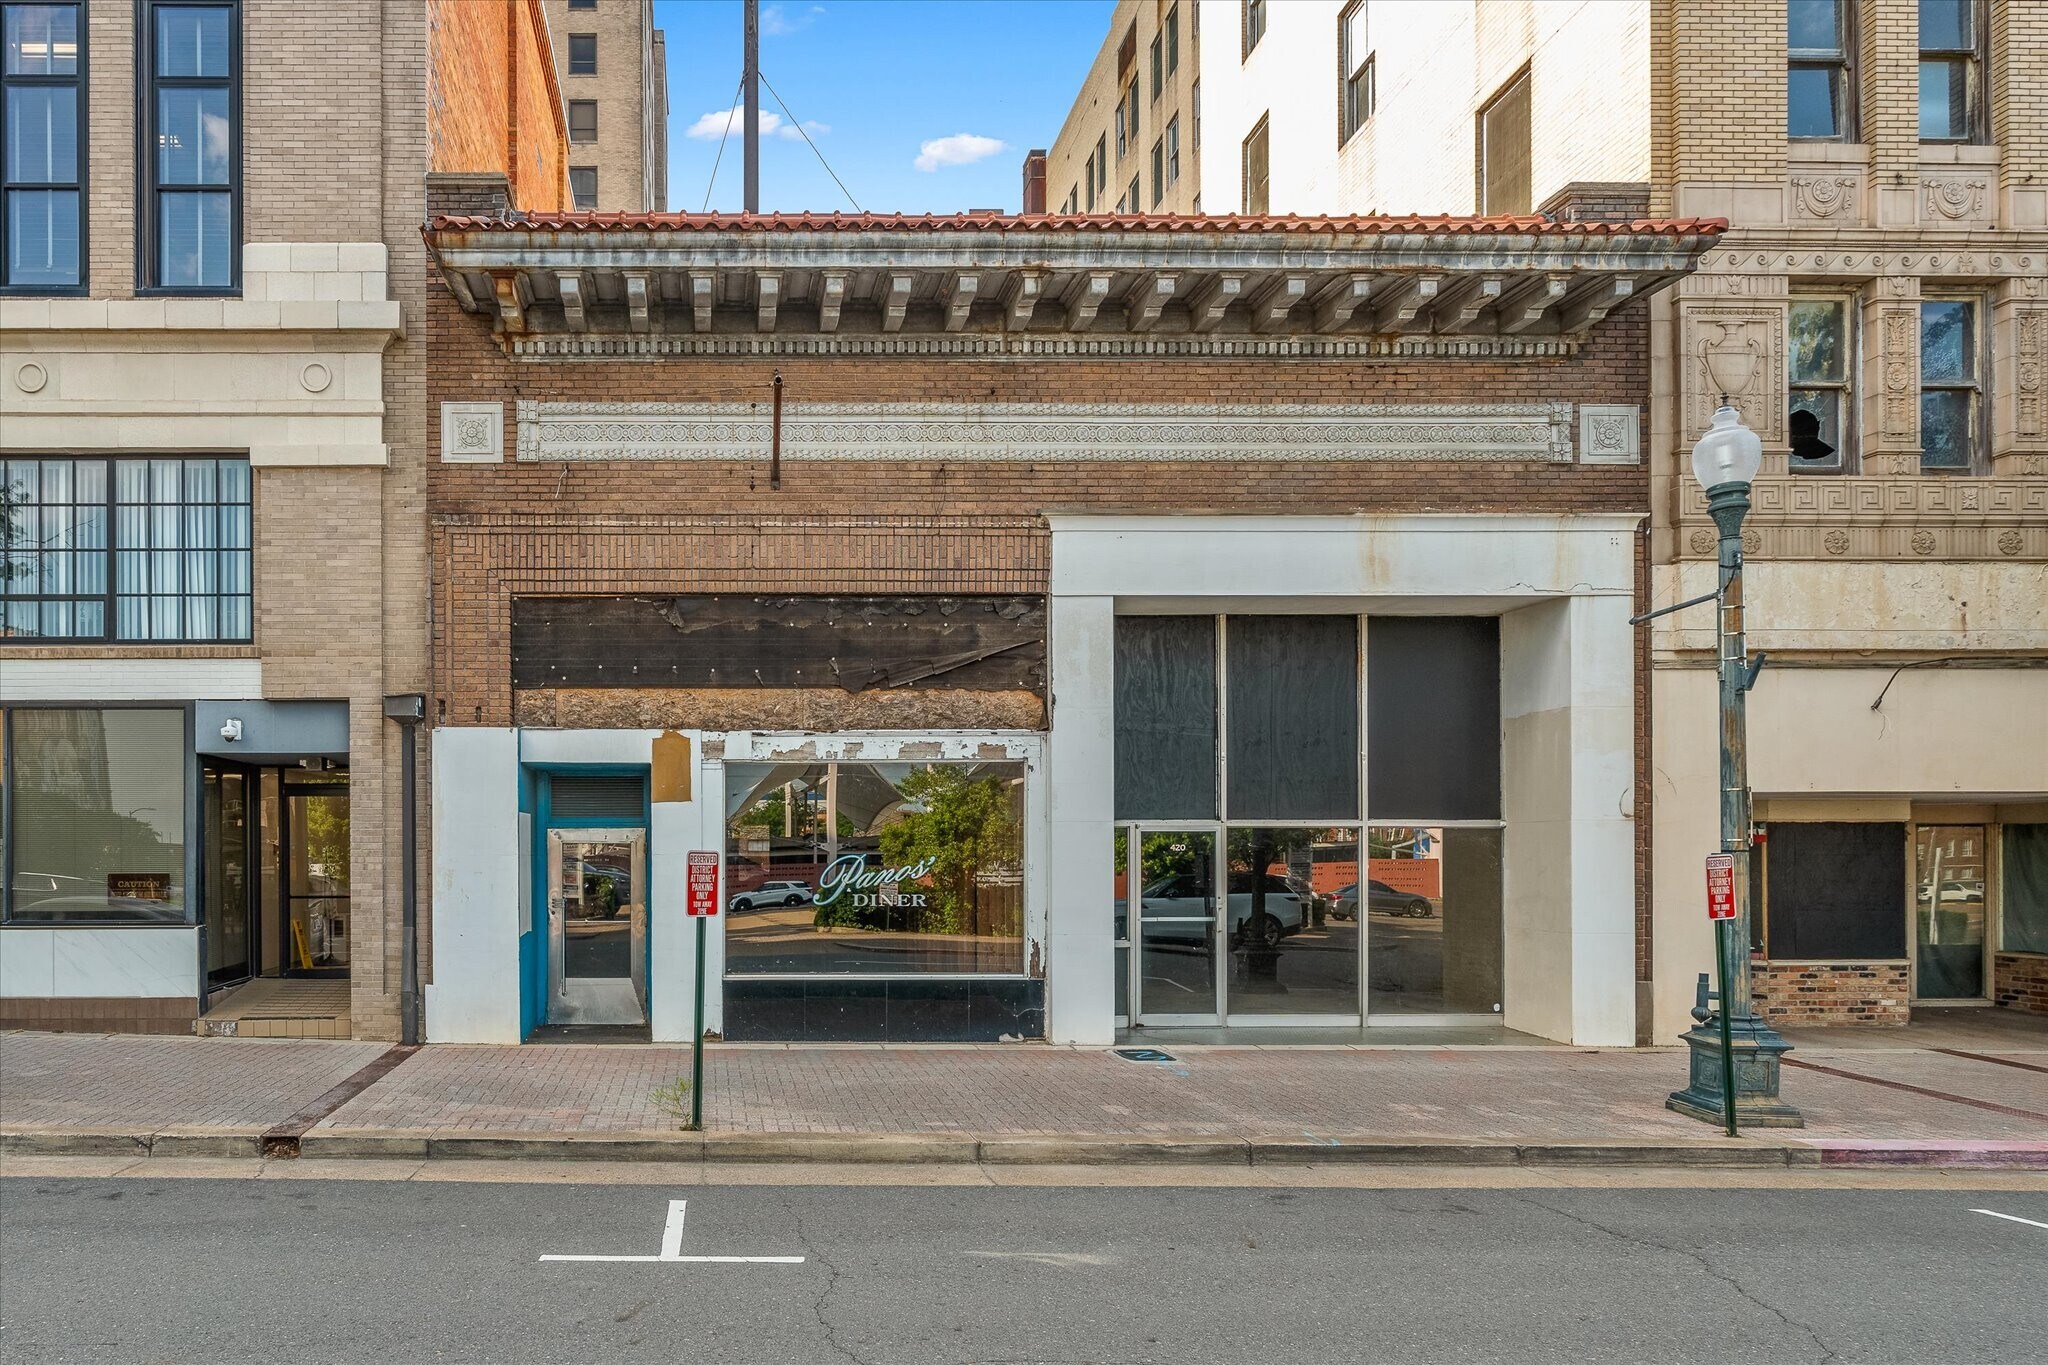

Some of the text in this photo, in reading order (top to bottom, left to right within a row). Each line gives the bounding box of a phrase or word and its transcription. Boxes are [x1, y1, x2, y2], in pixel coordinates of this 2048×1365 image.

[690, 855, 717, 864] RESERVED
[1707, 859, 1731, 868] RESERVED
[691, 865, 714, 874] DISTRICT
[690, 874, 716, 883] ATTORNEY
[813, 853, 936, 905] Panos'
[1709, 877, 1731, 887] ATTORNEY
[117, 880, 160, 888] CAUTION
[691, 882, 714, 892] PARKING
[1710, 886, 1730, 895] PARKING
[696, 891, 709, 900] ONLY
[852, 893, 927, 907] DINER
